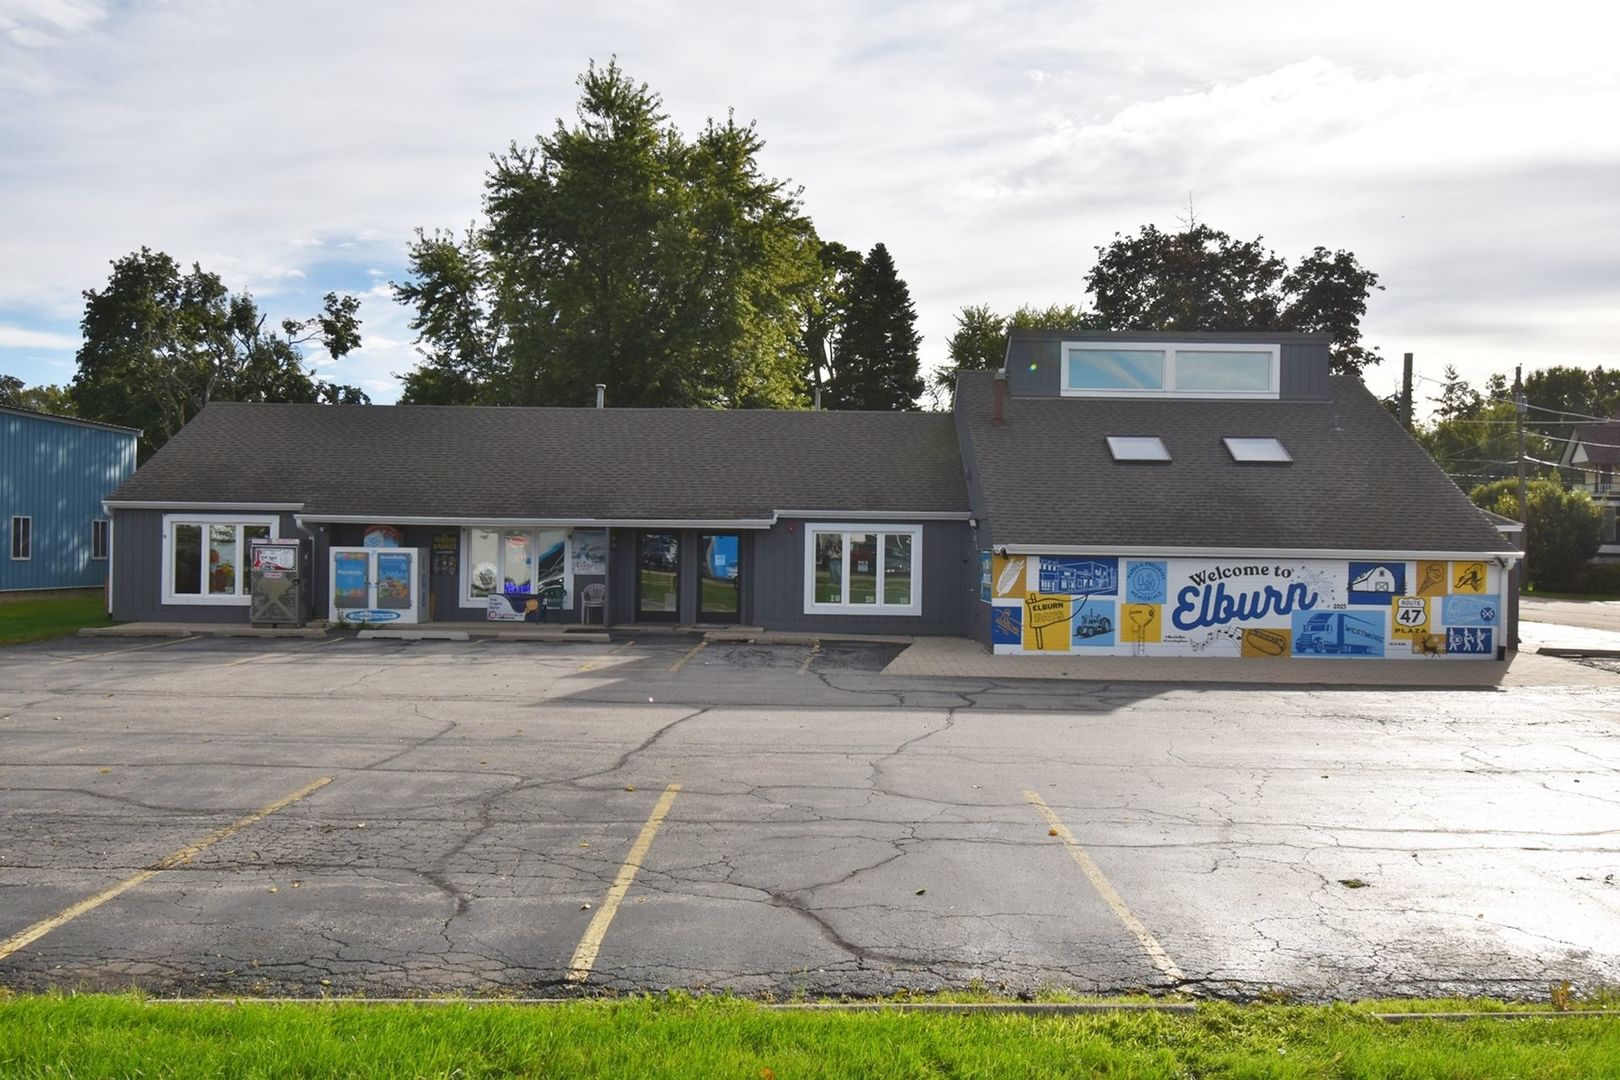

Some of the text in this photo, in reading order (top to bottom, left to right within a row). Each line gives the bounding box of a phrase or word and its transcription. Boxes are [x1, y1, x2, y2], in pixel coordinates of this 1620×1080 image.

[1189, 565, 1292, 586] Welcome to
[1032, 602, 1064, 611] ELBURN
[1172, 582, 1319, 631] Elburn
[1400, 609, 1422, 623] 47
